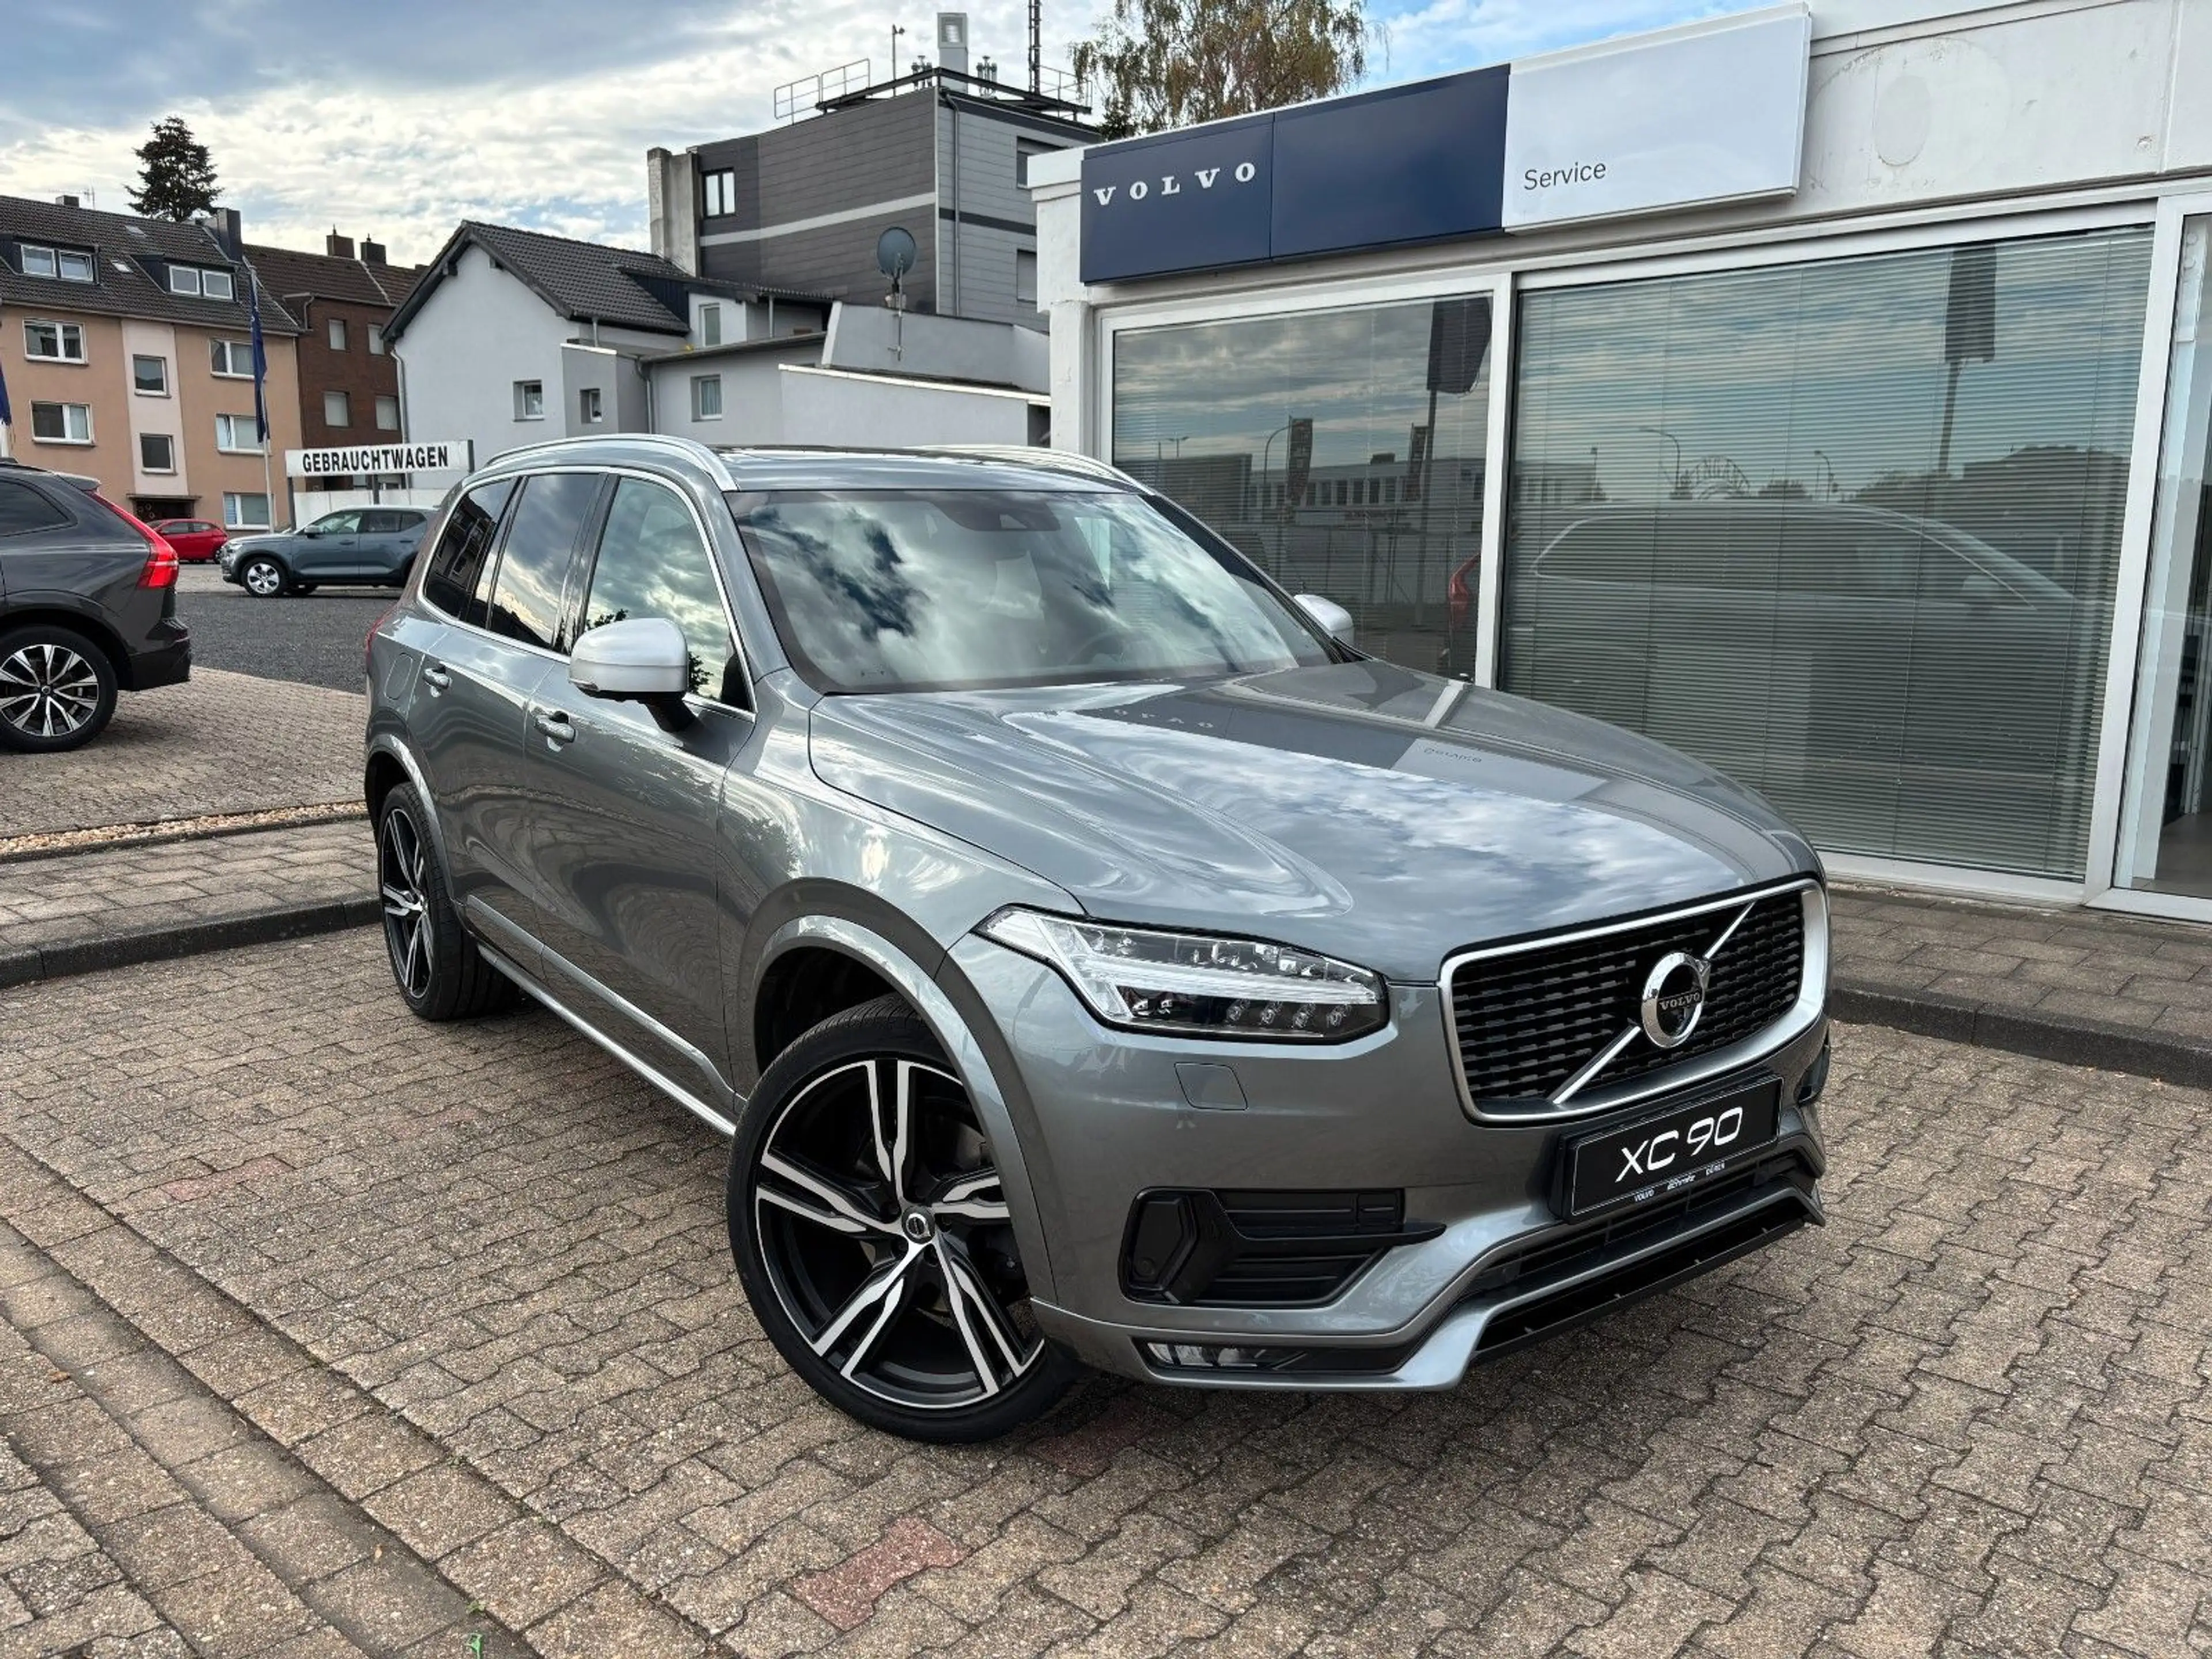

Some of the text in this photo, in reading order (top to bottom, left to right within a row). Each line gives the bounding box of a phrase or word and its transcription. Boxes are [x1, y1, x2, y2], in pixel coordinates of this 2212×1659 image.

[1093, 162, 1256, 206] VOLVO
[1524, 162, 1607, 191] Service
[302, 445, 449, 473] GEBRAUCHTWAGEN
[1659, 992, 1700, 1010] VOLVO
